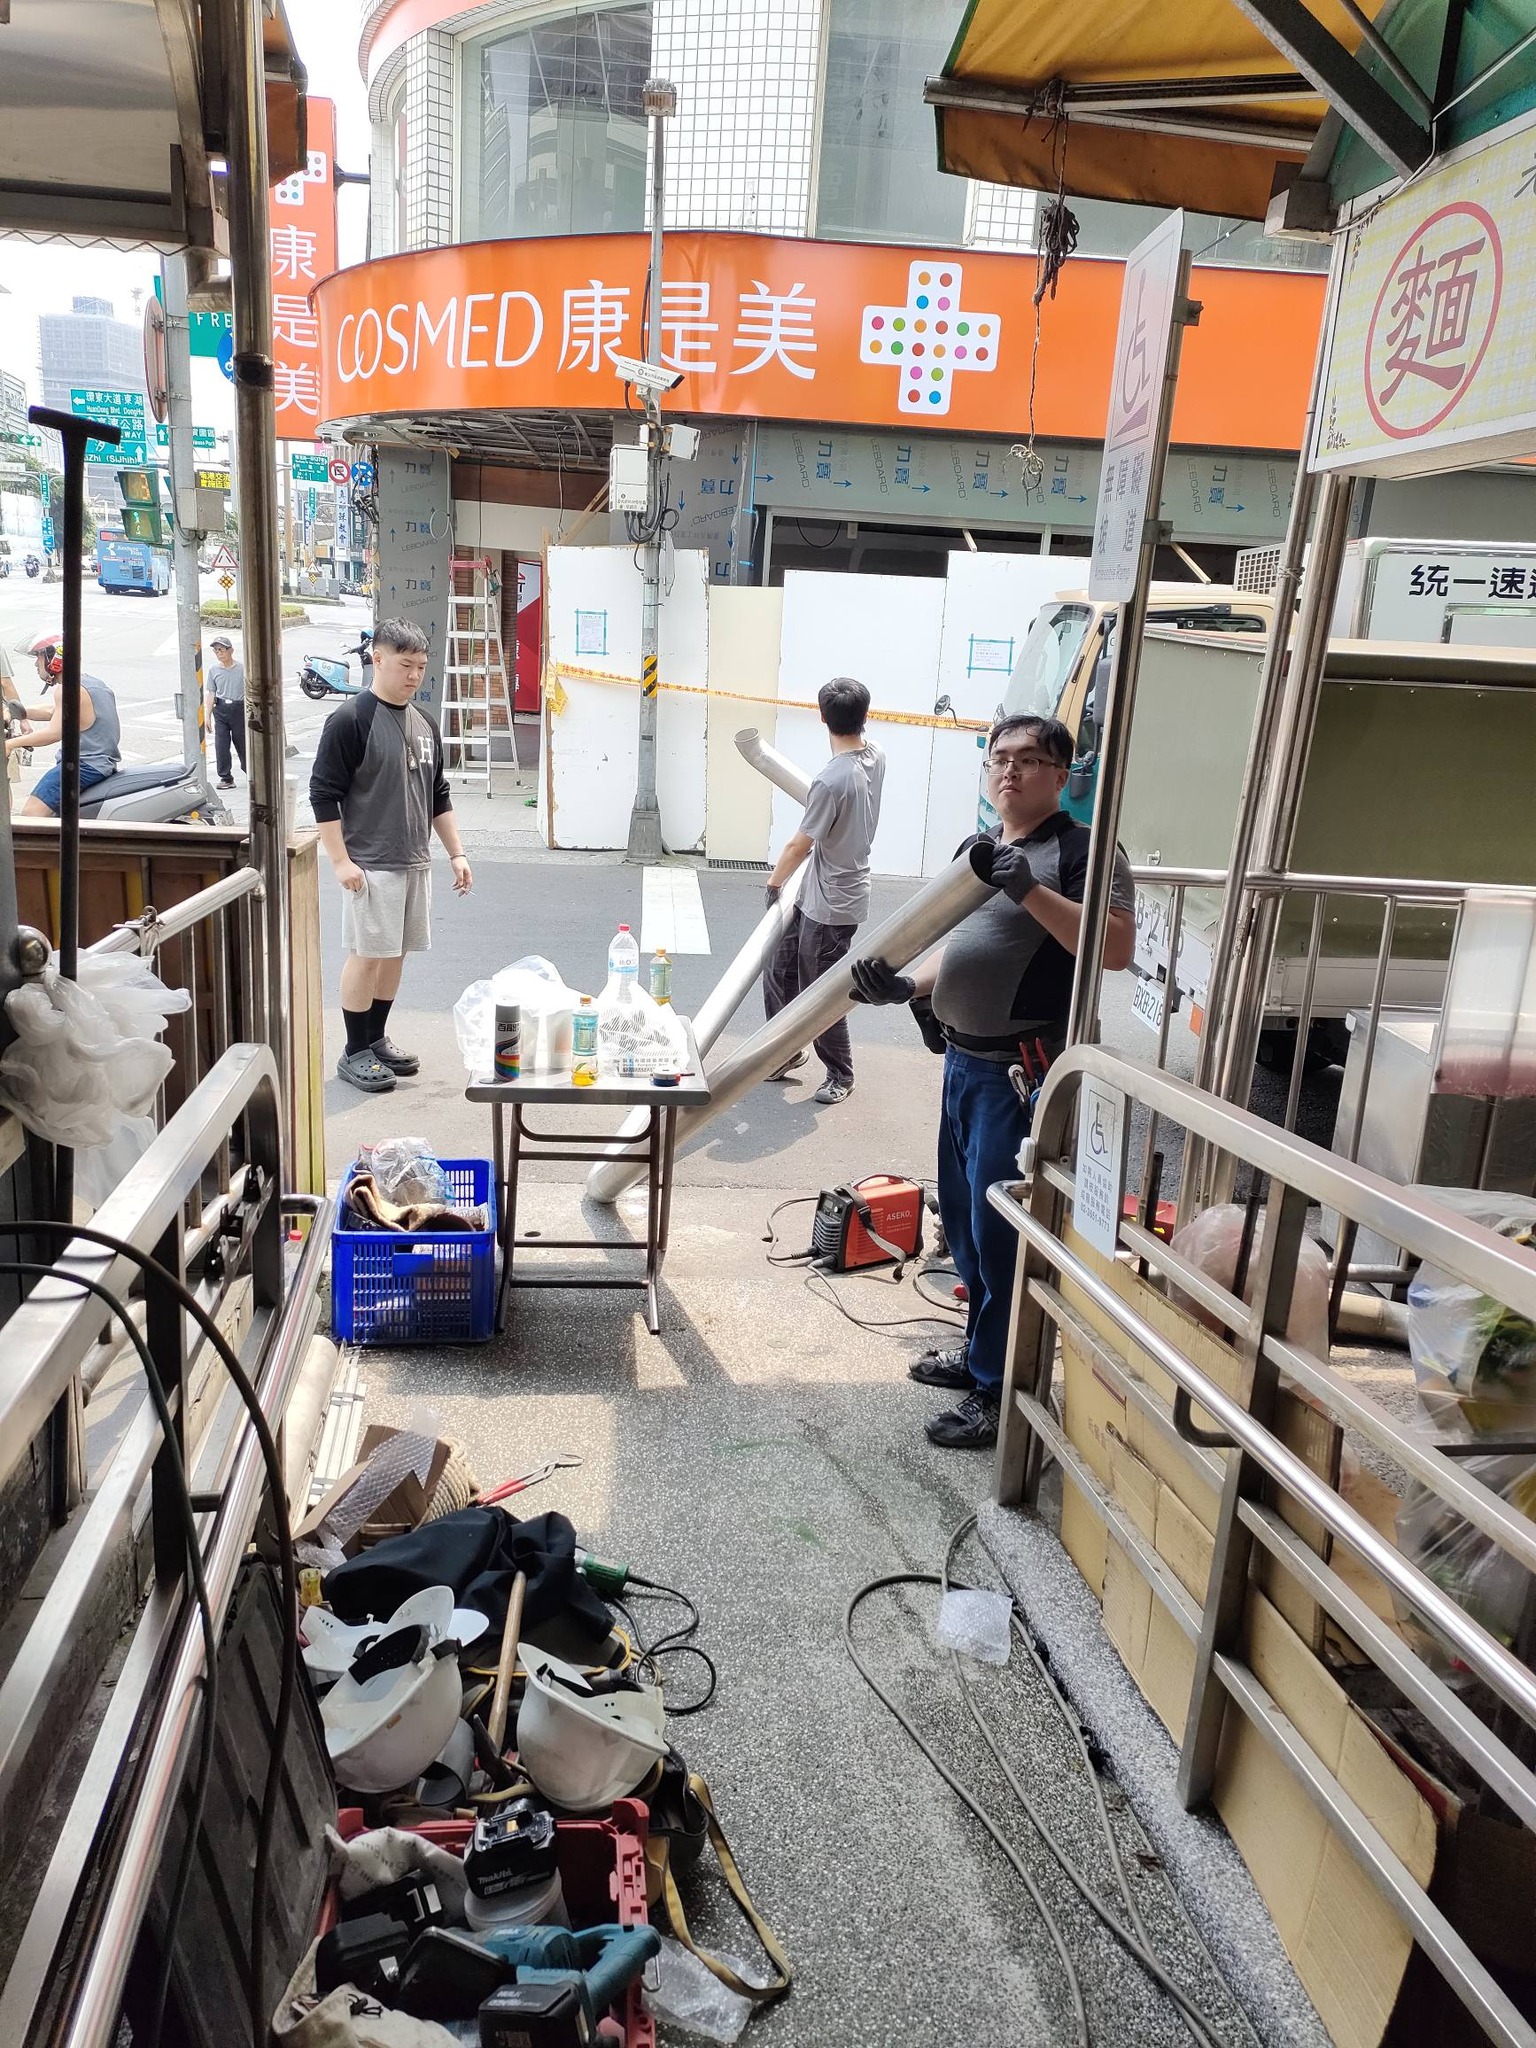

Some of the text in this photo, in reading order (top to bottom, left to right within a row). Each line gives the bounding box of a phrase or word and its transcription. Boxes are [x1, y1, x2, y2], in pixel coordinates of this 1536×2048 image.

[271, 224, 318, 416] 康是美
[337, 278, 818, 384] COSMED 康是美
[1380, 237, 1486, 406] 麵
[417, 736, 434, 764] H
